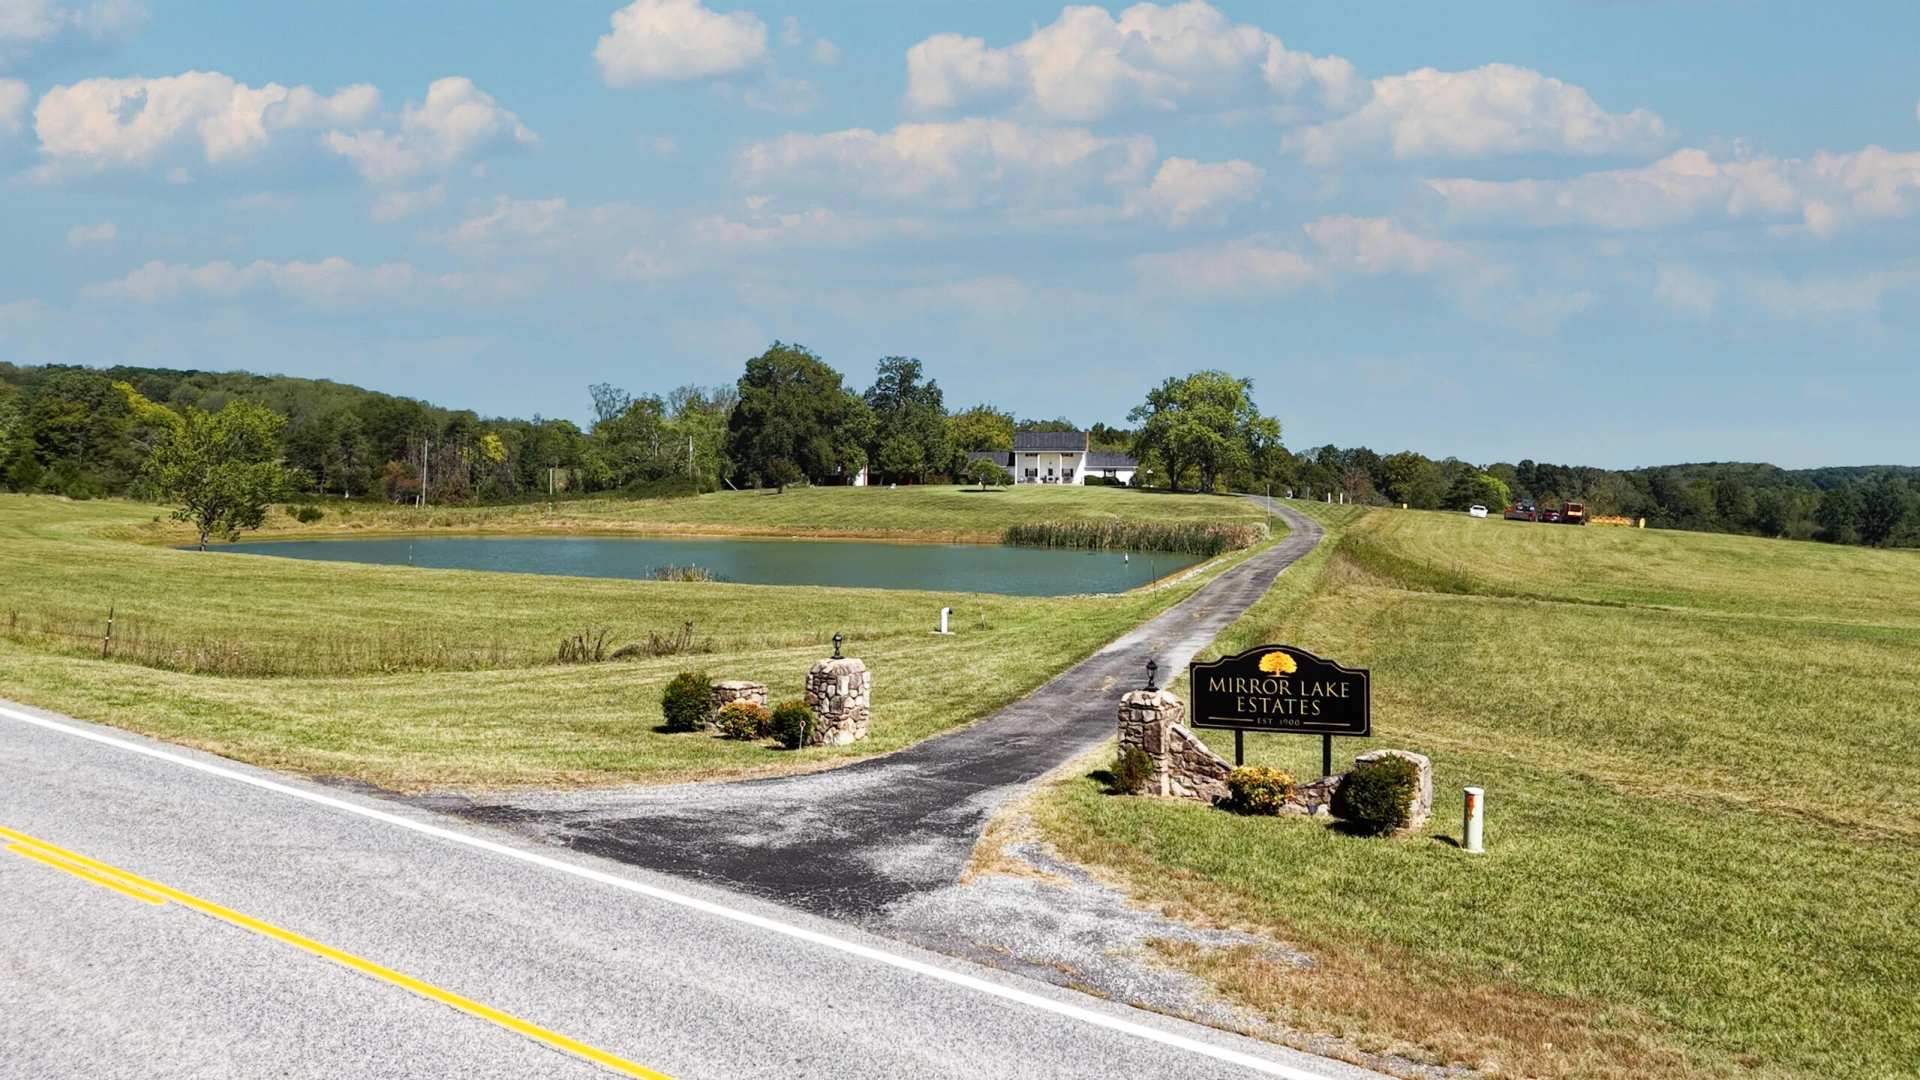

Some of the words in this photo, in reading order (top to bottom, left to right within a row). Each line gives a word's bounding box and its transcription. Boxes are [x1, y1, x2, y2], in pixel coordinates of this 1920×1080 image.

[1209, 677, 1292, 696] MIRROR
[1301, 681, 1350, 698] LAKE
[1237, 697, 1321, 716] ESTATES
[1279, 718, 1300, 726] 1900
